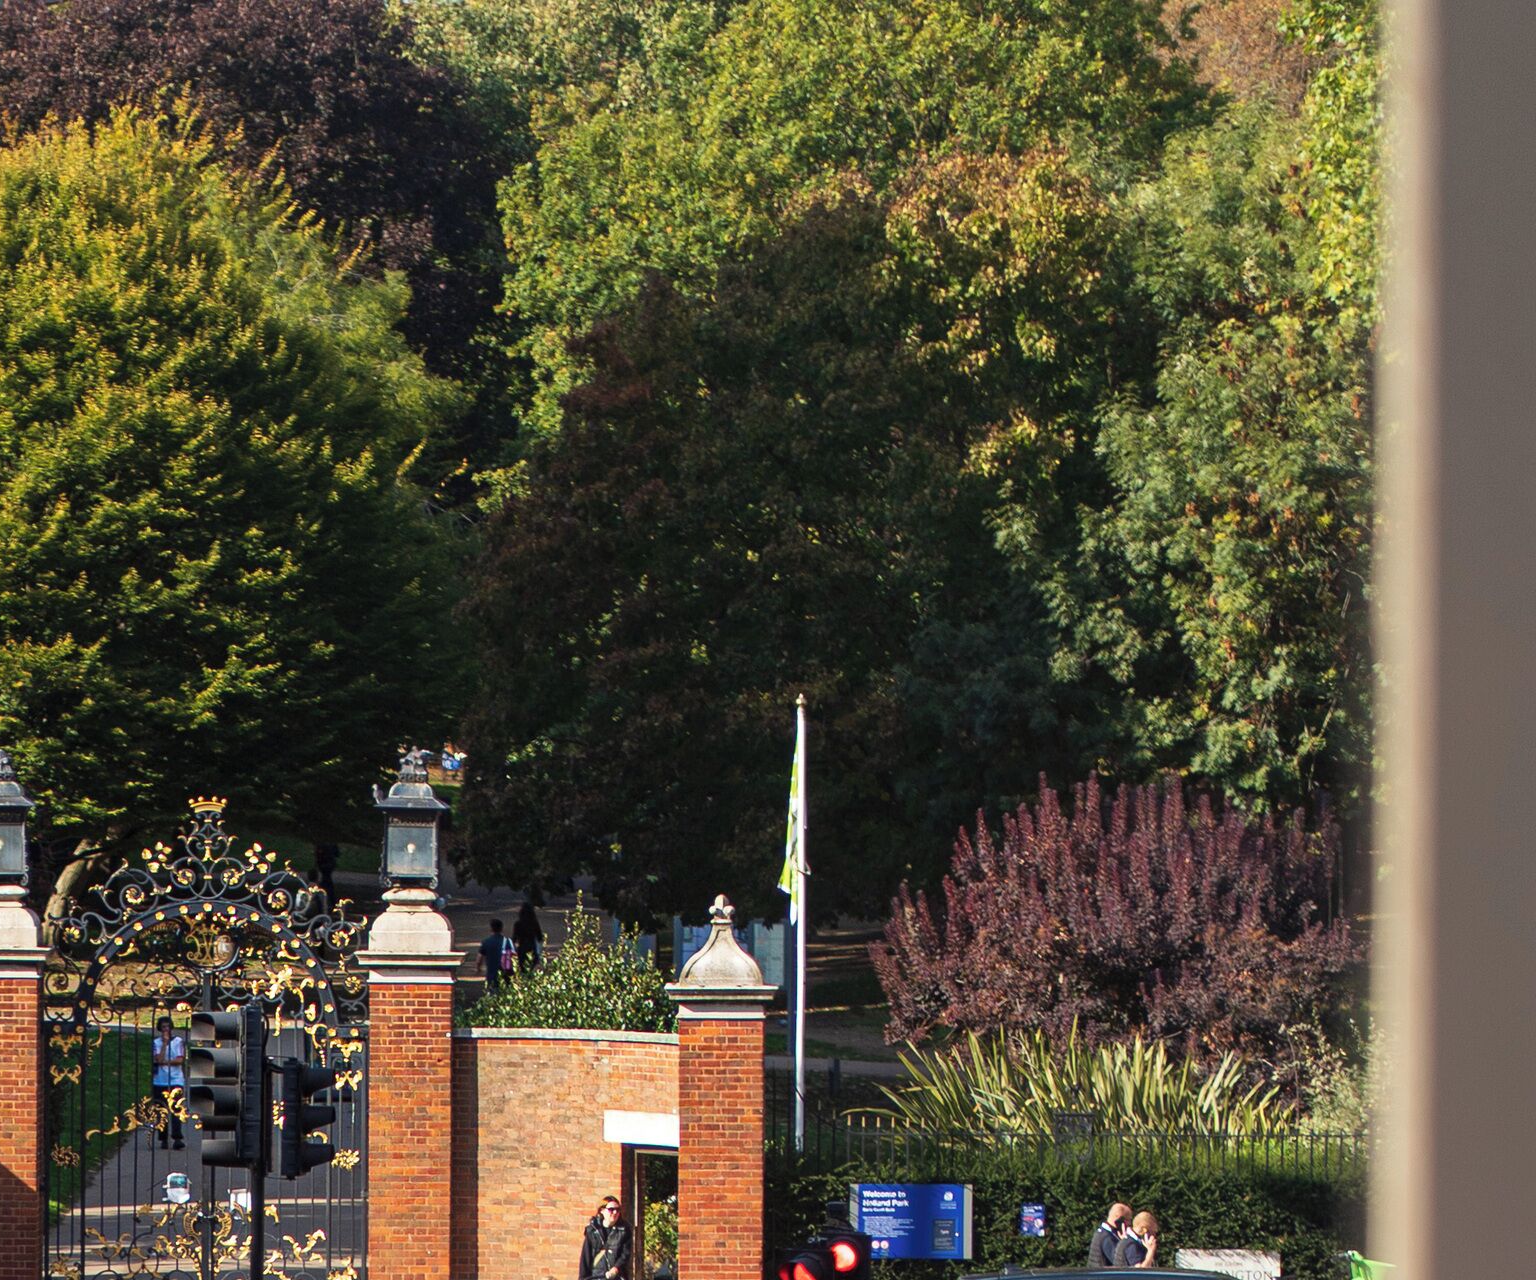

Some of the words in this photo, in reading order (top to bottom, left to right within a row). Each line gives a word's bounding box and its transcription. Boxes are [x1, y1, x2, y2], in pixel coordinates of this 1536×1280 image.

[862, 1190, 897, 1198] Welcome
[898, 1190, 907, 1198] to
[862, 1199, 891, 1207] Holland
[892, 1199, 910, 1207] Park
